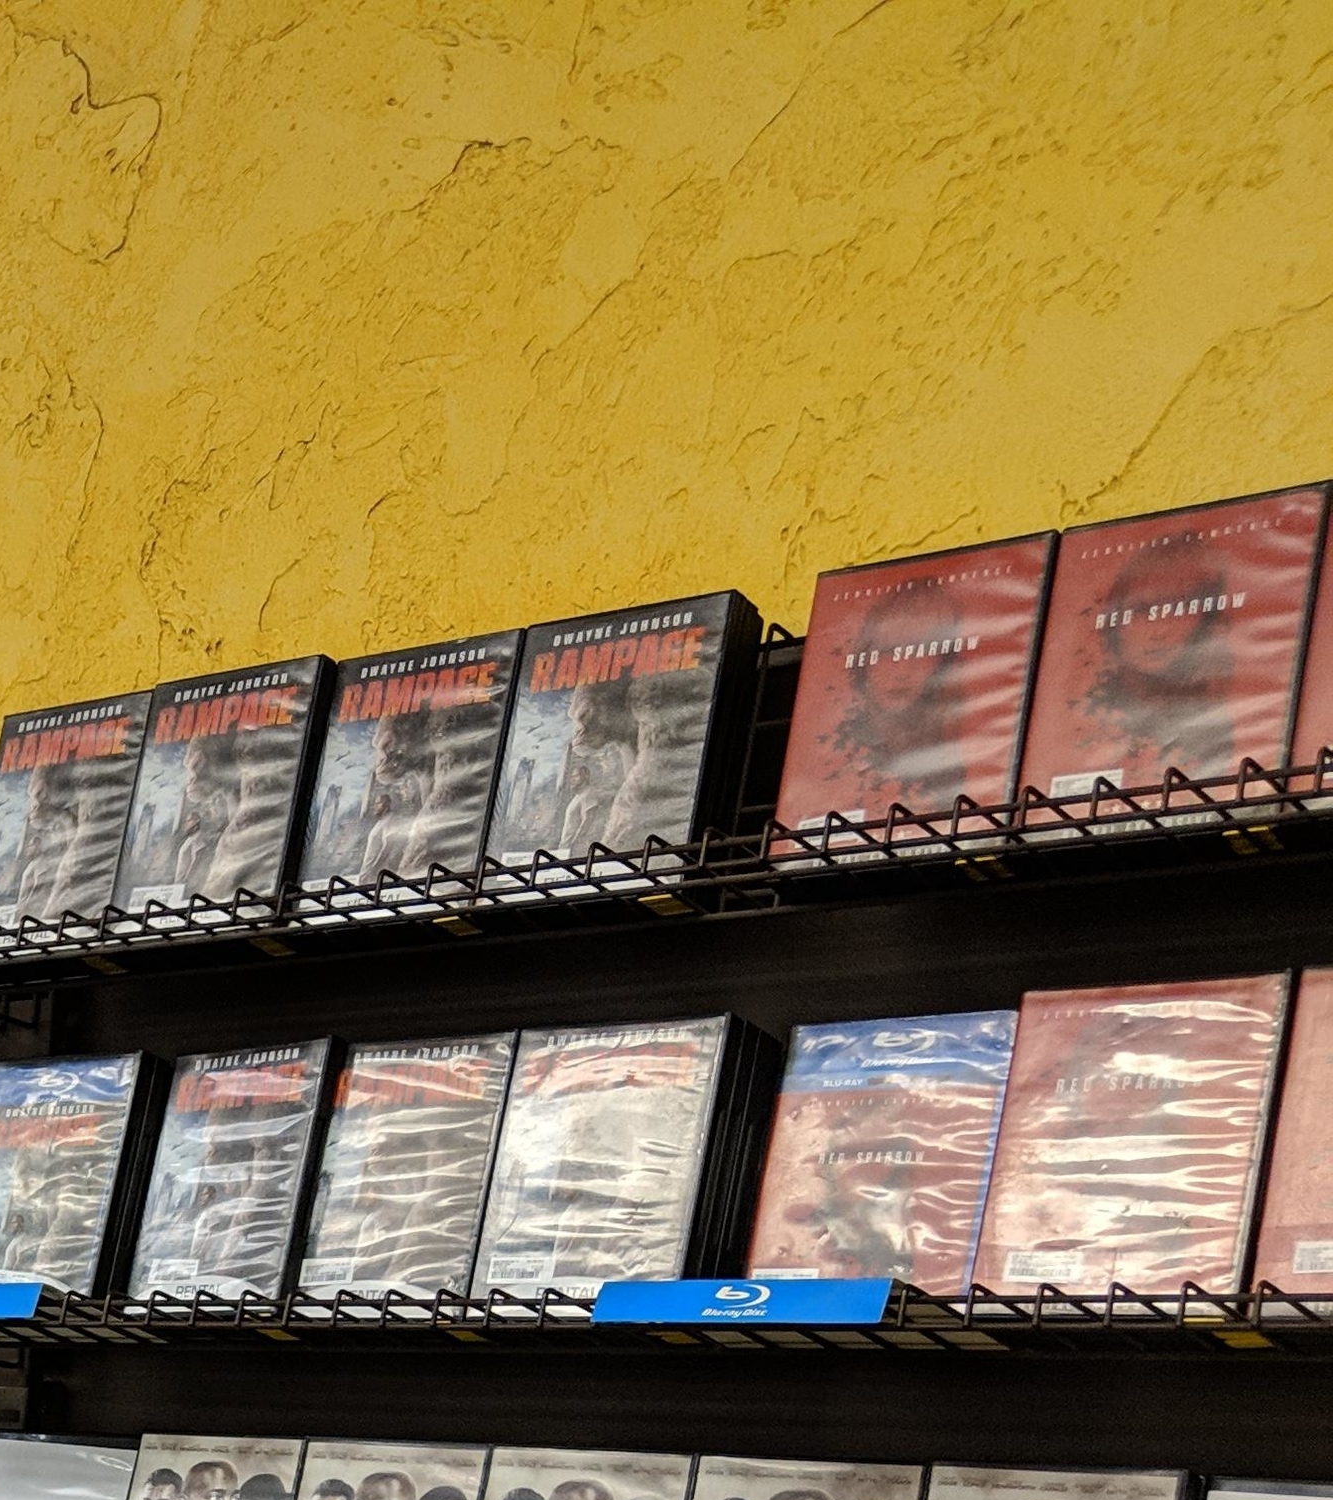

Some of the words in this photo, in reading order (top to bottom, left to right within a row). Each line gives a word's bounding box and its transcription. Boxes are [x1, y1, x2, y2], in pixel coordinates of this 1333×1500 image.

[553, 626, 613, 647] DWAYNE
[619, 610, 693, 636] JOHNSON
[1095, 609, 1134, 630] RED
[1148, 591, 1248, 623] SPARROW
[360, 660, 414, 679] DWAYNE
[420, 647, 488, 671] JOHNSON
[530, 626, 707, 695] RAMPAGE
[845, 650, 879, 670] RED
[893, 634, 980, 662] SPARROW
[174, 685, 222, 703] DWAYNE
[227, 672, 289, 695] JOHNSON
[339, 662, 499, 725] RAMPAGE
[154, 687, 299, 745] RAMPAGE
